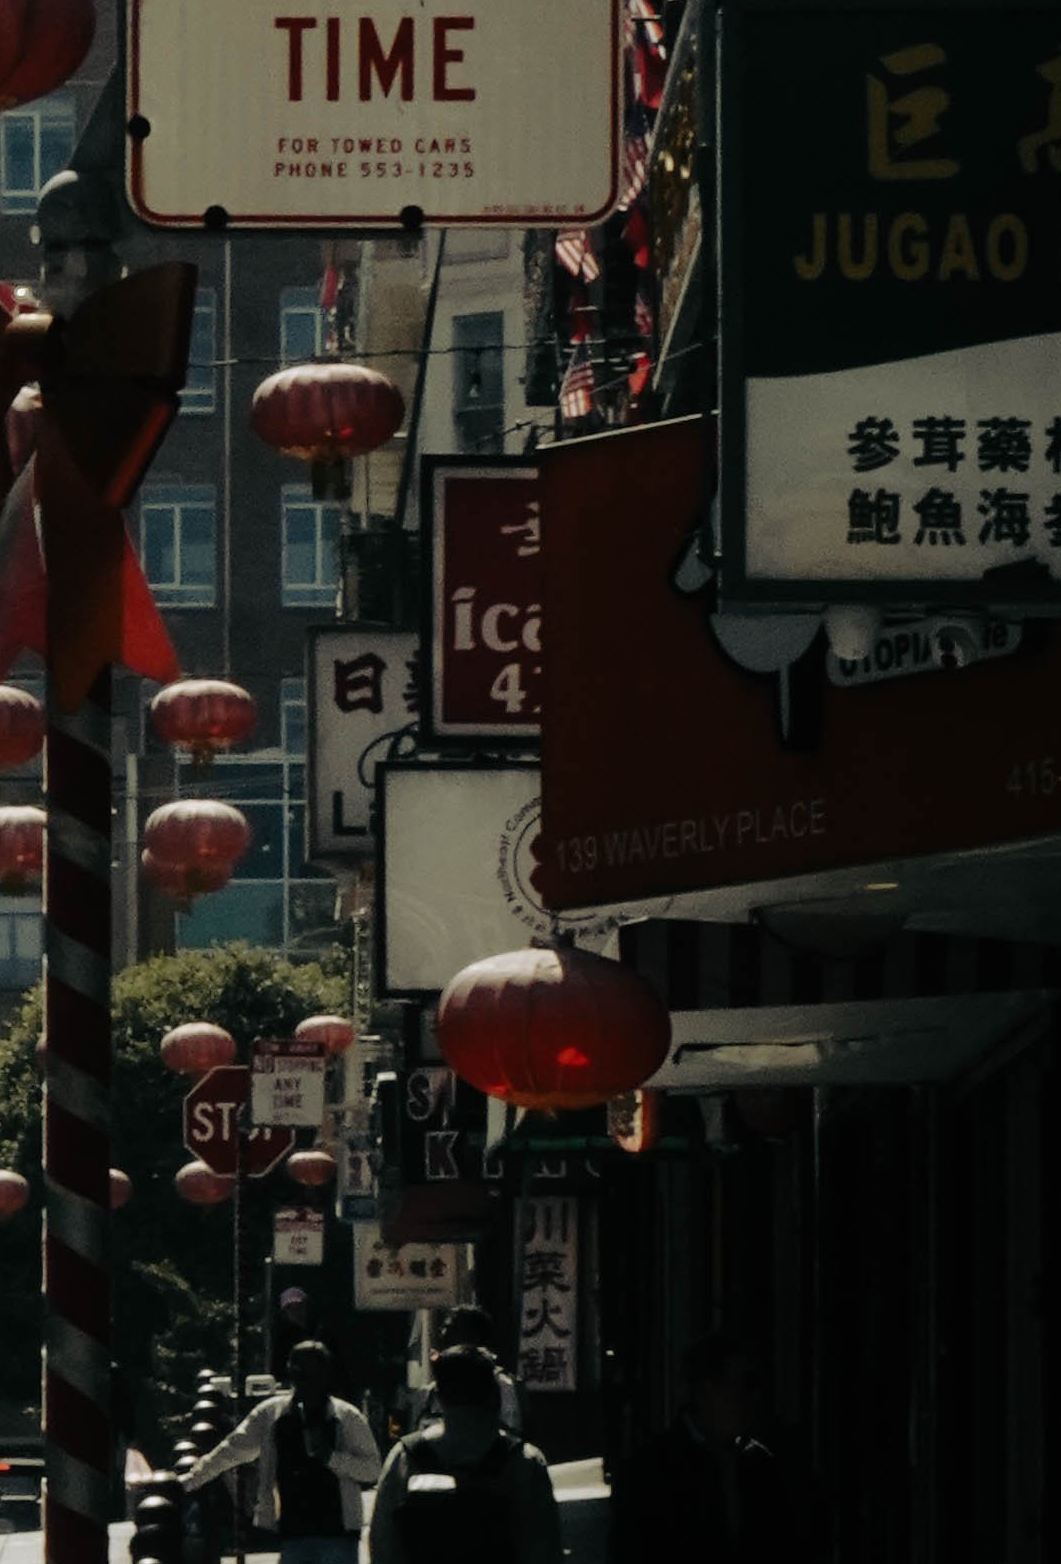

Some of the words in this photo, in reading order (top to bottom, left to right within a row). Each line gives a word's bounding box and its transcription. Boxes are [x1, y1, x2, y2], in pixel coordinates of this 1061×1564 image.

[275, 16, 477, 102] TIME
[274, 162, 347, 178] PHONE
[360, 161, 476, 178] 553-1235
[278, 138, 319, 154] FOR
[331, 138, 402, 154] TOWED
[415, 138, 472, 154] CARS
[794, 212, 1029, 283] JUGAO
[555, 833, 600, 875] 139
[603, 814, 734, 868] WAVERLY
[736, 798, 827, 845] PLACE
[191, 1101, 273, 1143] ST
